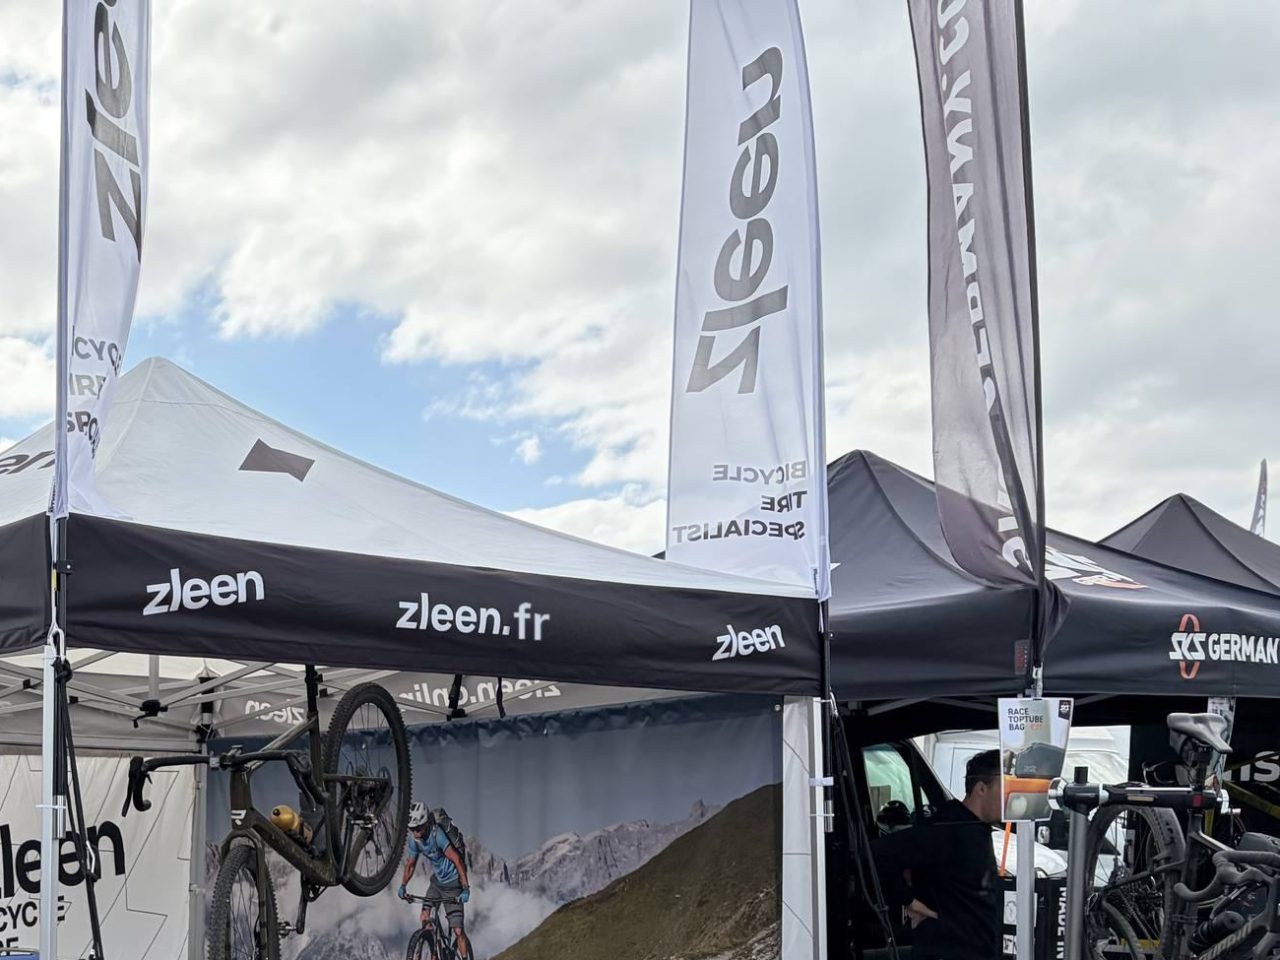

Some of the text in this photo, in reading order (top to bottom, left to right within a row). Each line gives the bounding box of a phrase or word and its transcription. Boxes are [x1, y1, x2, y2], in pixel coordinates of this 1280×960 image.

[85, 0, 141, 264] zle
[143, 567, 265, 617] zleen
[396, 592, 550, 642] zleen.fr
[712, 620, 786, 661] zleen
[1169, 632, 1280, 664] SKS GERMAN
[1008, 708, 1030, 716] RACE
[1009, 723, 1025, 731] BAG
